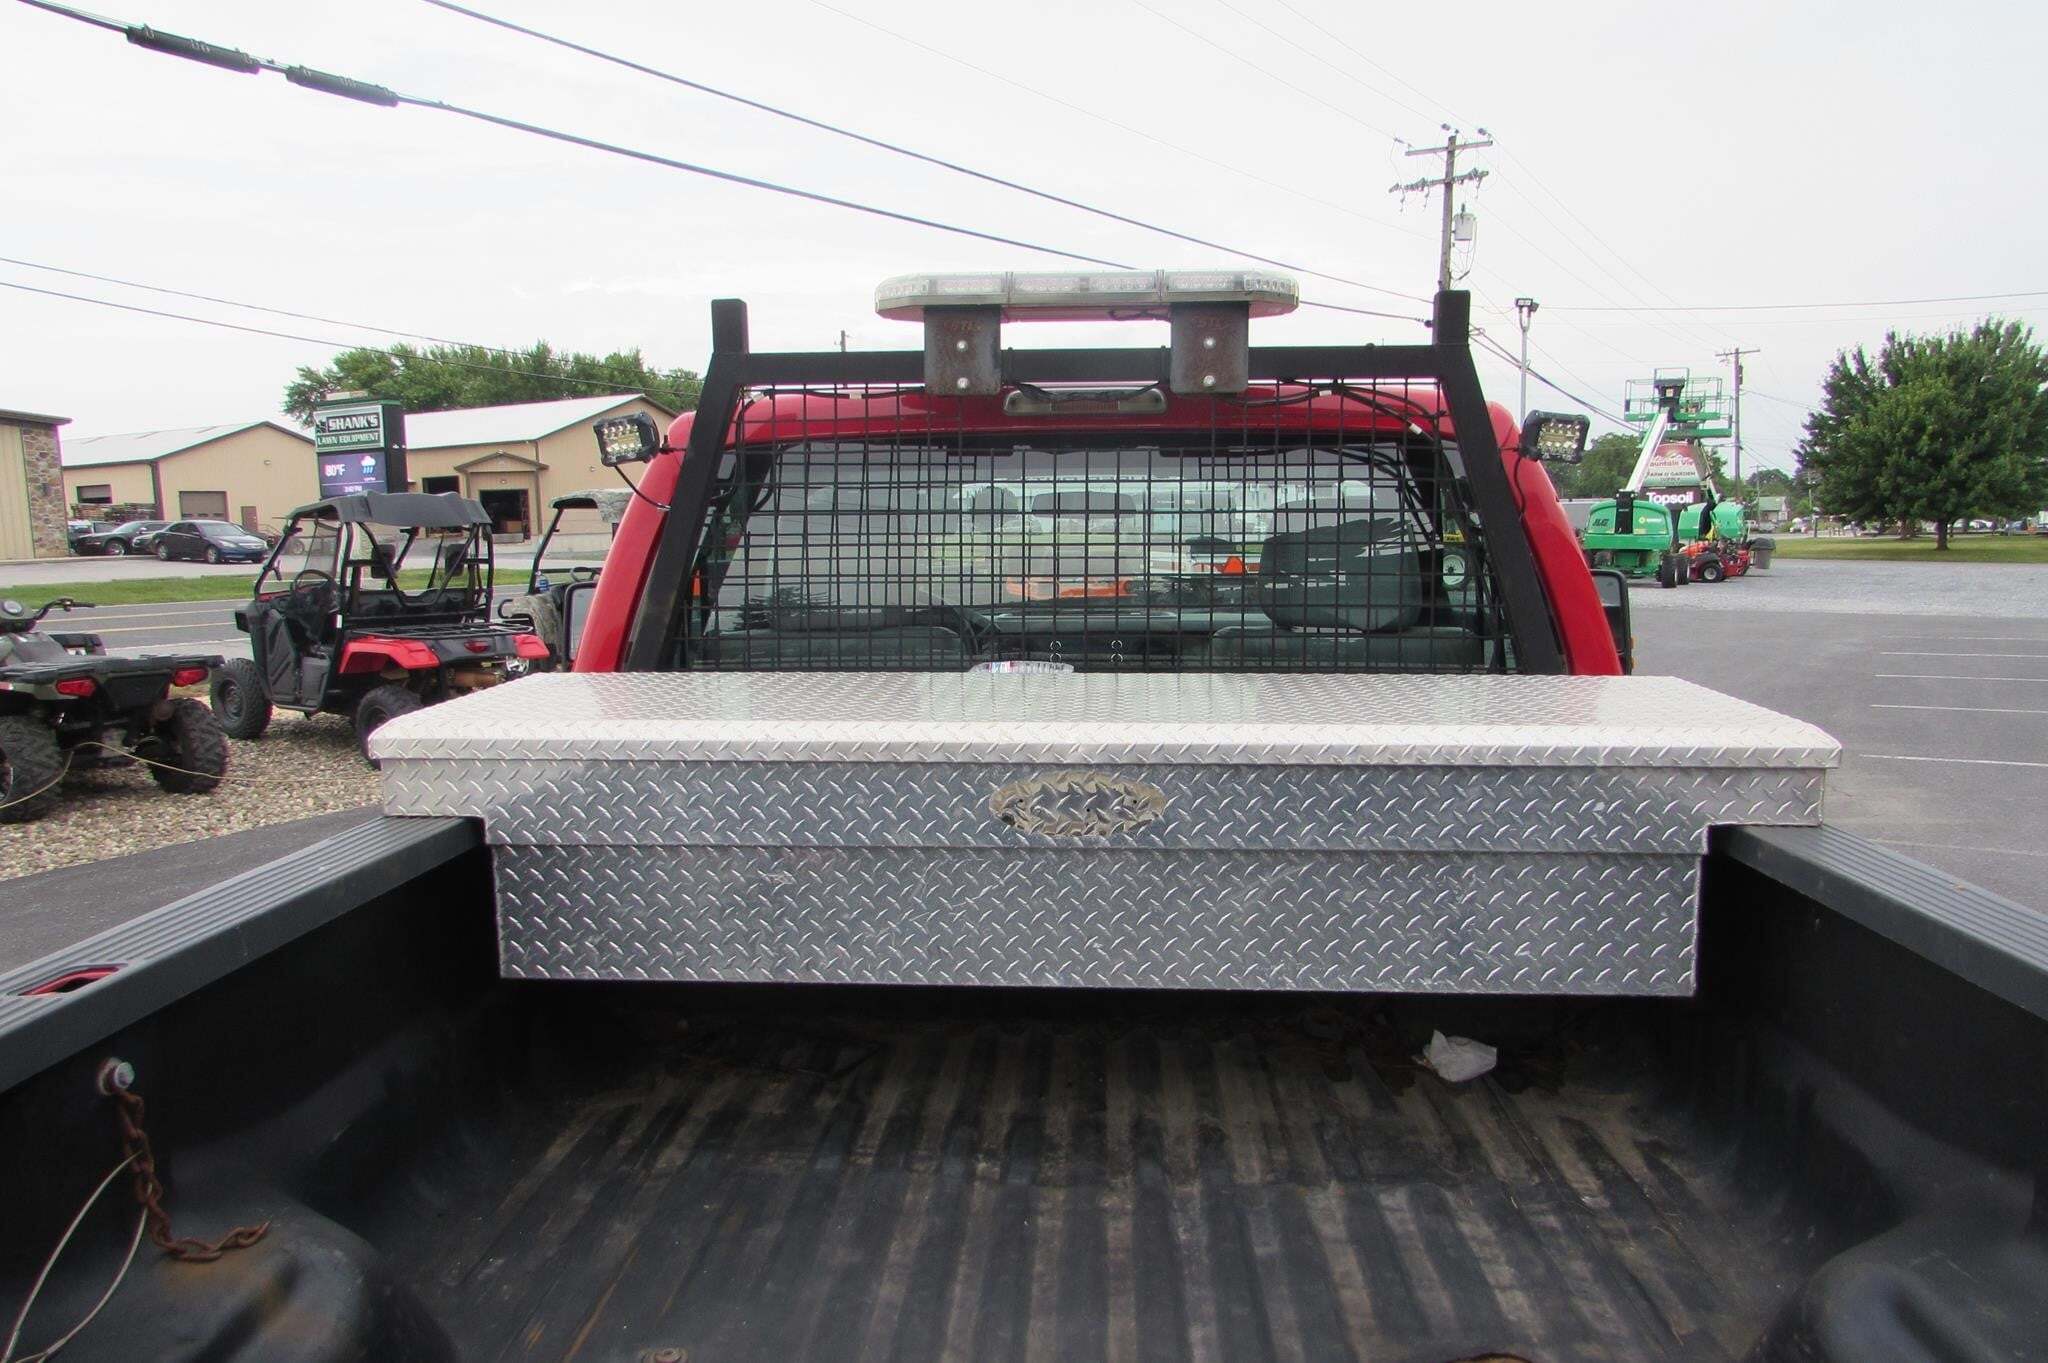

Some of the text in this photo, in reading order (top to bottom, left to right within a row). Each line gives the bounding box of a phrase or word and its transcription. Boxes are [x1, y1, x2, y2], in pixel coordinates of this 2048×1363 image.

[329, 415, 379, 430] SHANK'S
[317, 432, 379, 445] LAWN EQUIPMENT
[1649, 459, 1679, 468] ountain
[1646, 491, 1694, 506] Topsoil
